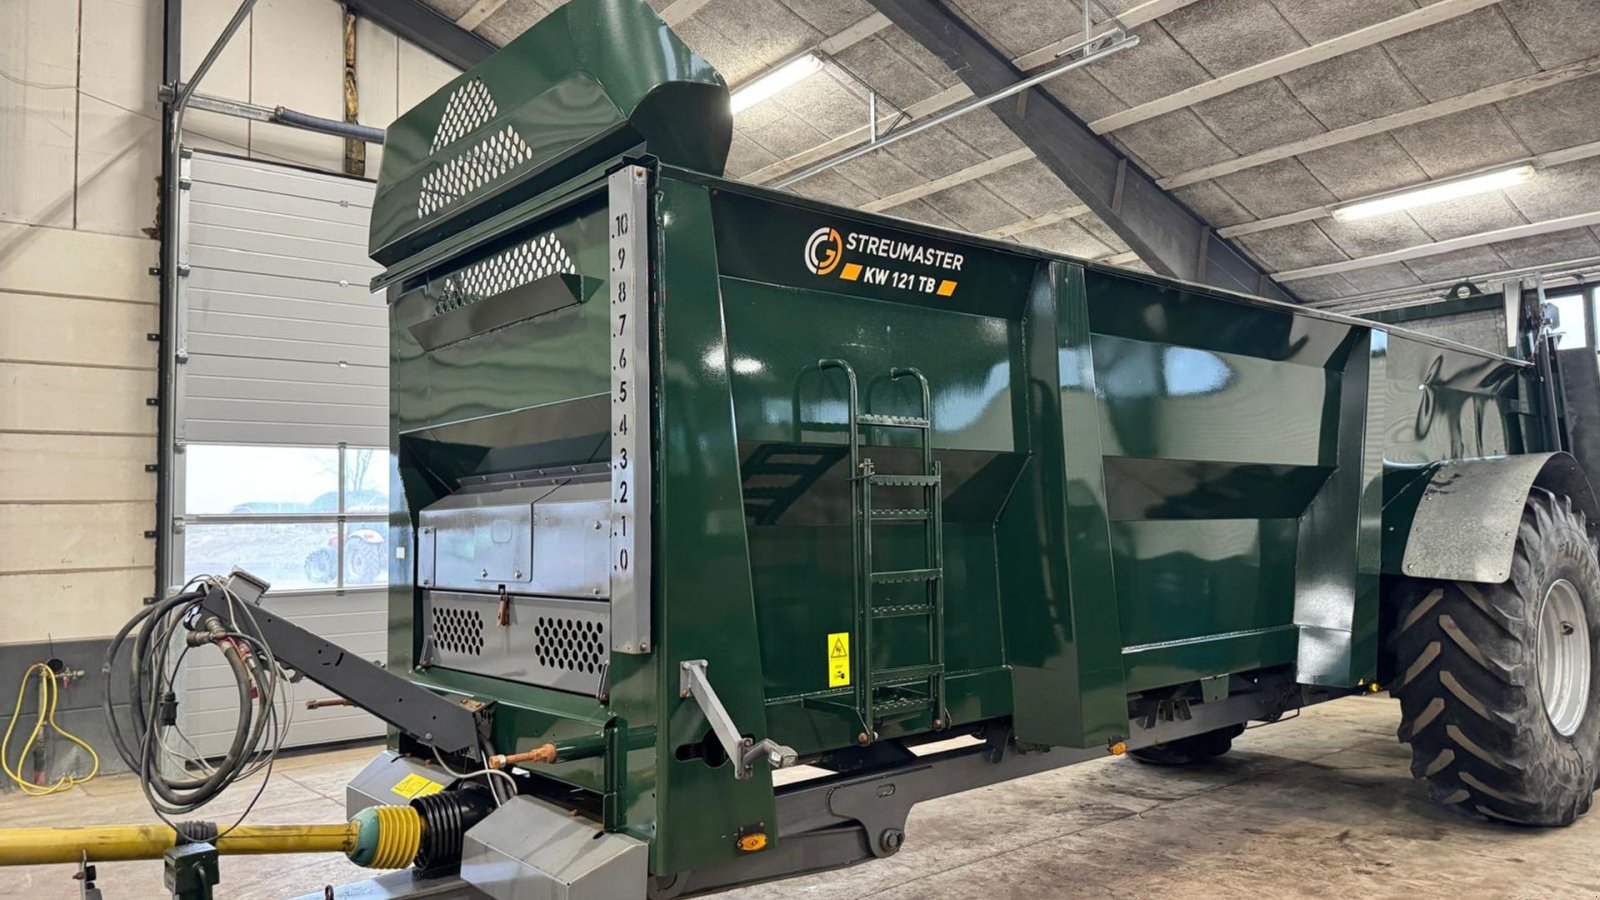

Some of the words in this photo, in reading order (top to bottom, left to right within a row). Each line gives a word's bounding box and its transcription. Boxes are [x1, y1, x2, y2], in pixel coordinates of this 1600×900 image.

[846, 232, 964, 271] STREUMASTER
[863, 266, 889, 286] KW
[892, 272, 914, 290] 121
[918, 276, 935, 293] TB
